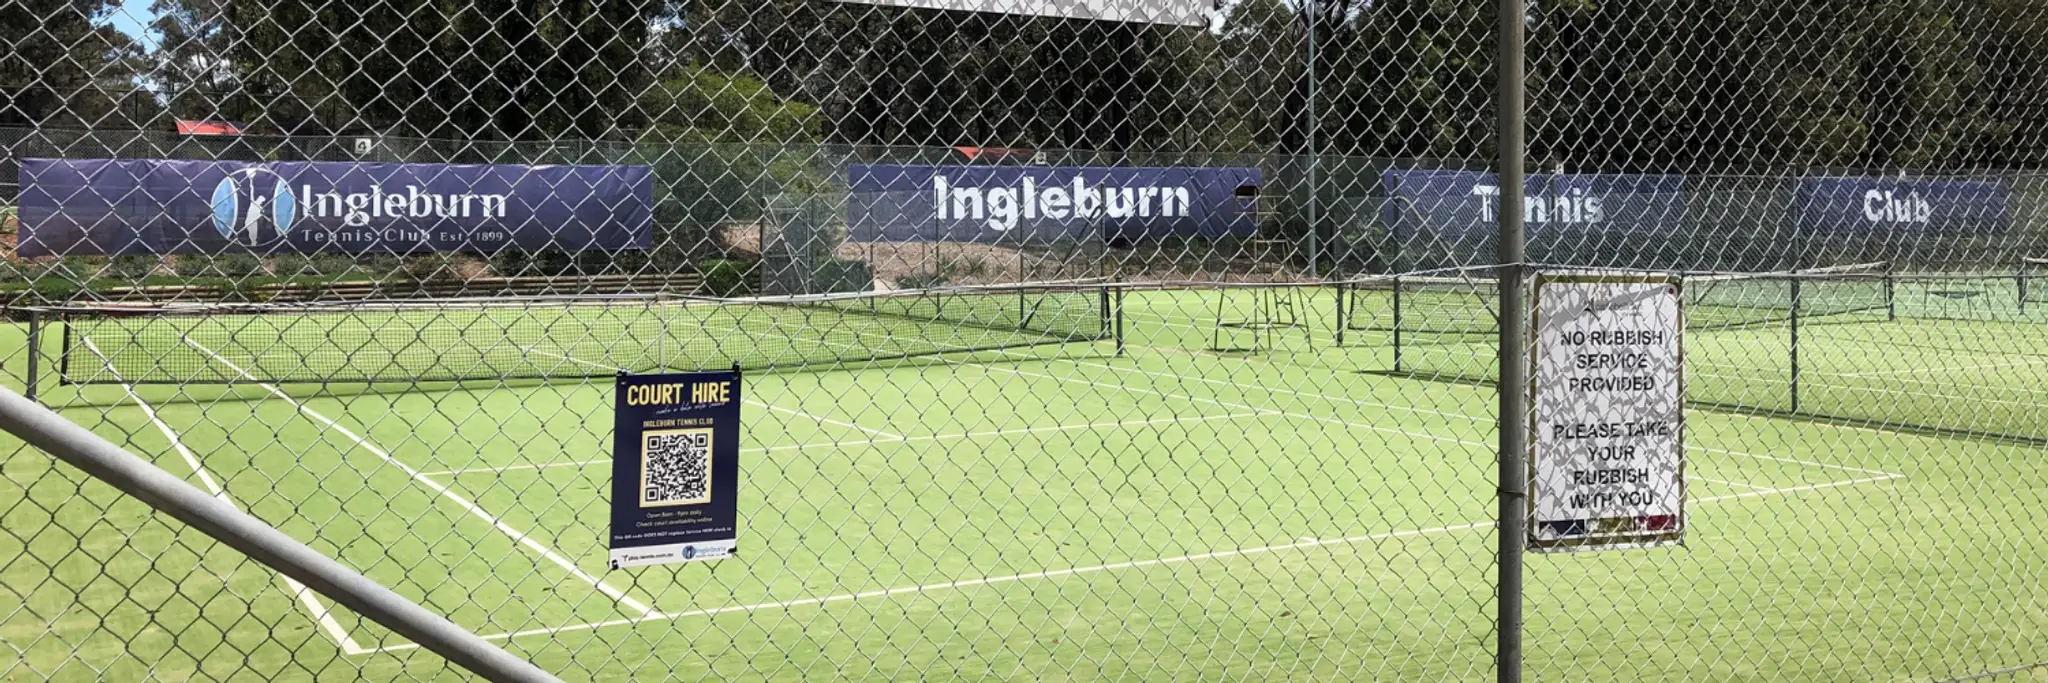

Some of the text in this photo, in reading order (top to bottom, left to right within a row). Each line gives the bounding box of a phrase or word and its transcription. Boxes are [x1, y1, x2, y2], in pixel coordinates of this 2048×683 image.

[302, 184, 506, 227] Ingleburn
[934, 175, 1190, 231] Ingleburn
[1473, 185, 1604, 223] Tnnis
[1863, 188, 1931, 224] Club
[301, 229, 373, 242] Tennis
[384, 229, 432, 242] Club
[476, 231, 504, 242] 1899
[1560, 331, 1663, 346] NO RUBBISH
[1576, 354, 1648, 369] SERVICE
[1569, 376, 1655, 392] PROVIDED
[627, 381, 731, 406] COURT HIRE
[677, 418, 698, 427] TENNIS
[699, 417, 714, 426] CLUB
[1554, 421, 1669, 440] PLEASE TAKE
[1587, 446, 1635, 460] YOUR
[1573, 469, 1649, 486] RUBBISH
[1569, 491, 1654, 510] WITH YOU
